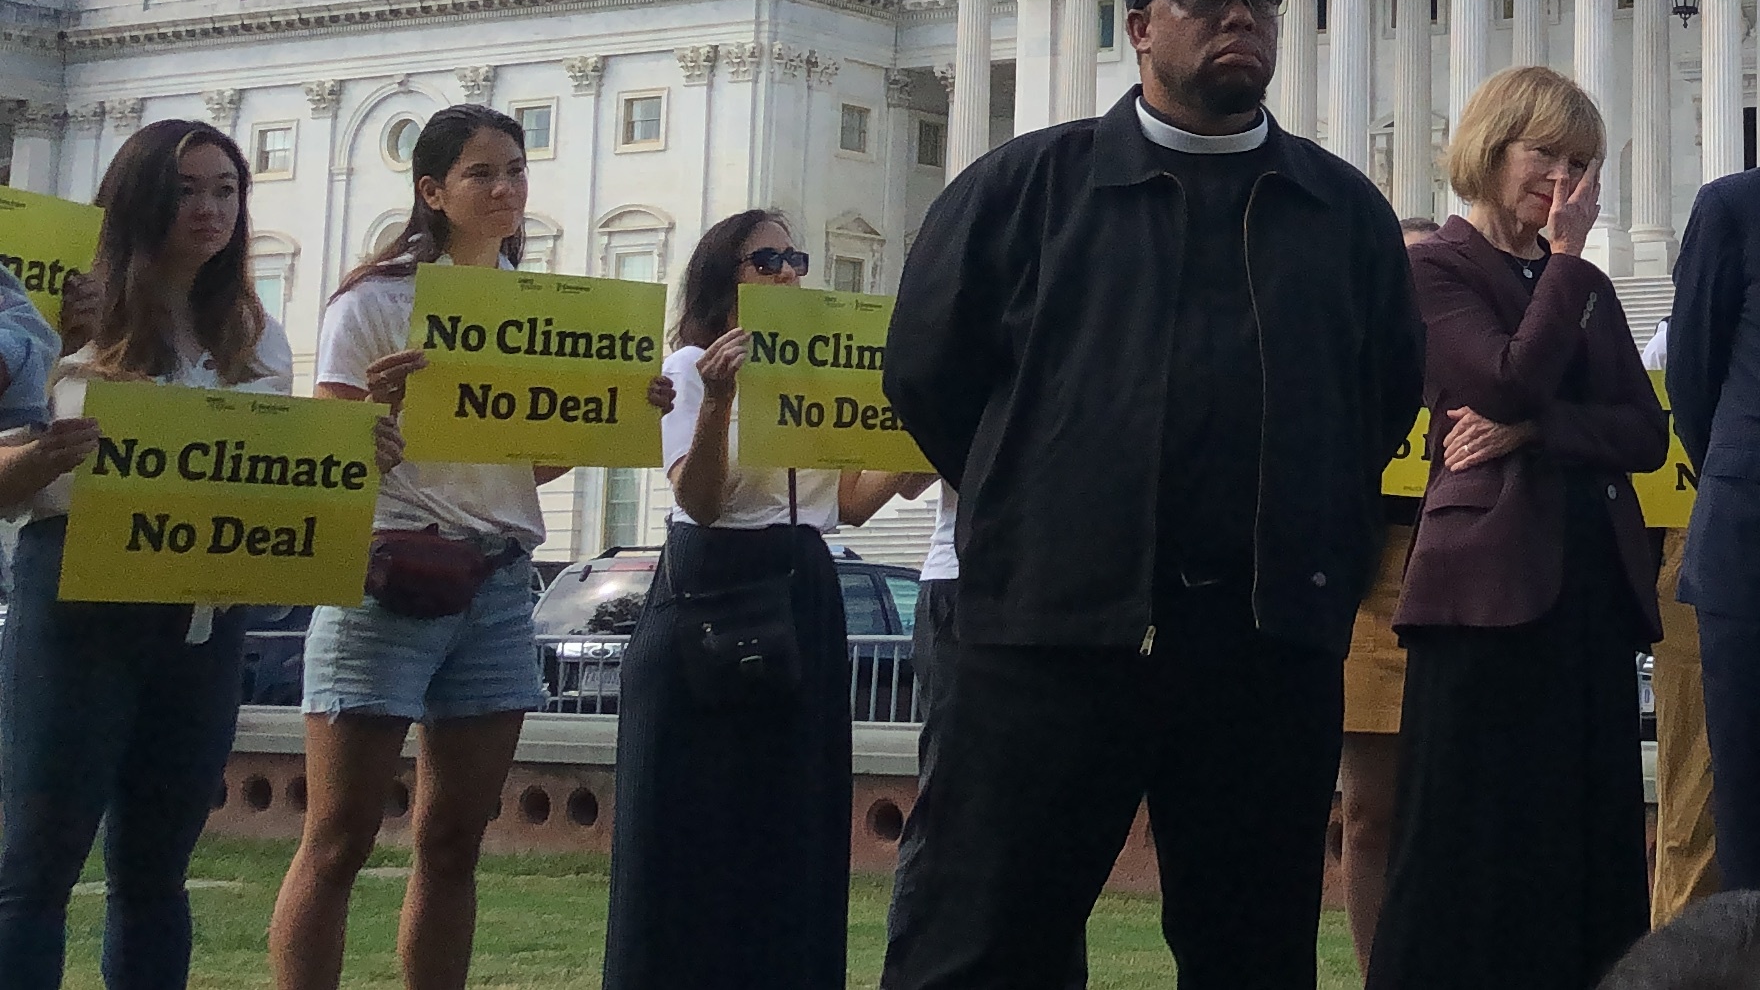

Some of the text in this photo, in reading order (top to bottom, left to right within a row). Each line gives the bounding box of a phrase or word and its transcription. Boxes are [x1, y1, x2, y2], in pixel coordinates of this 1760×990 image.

[423, 314, 655, 363] No Climate
[751, 331, 886, 370] No Clim
[455, 383, 618, 424] No Deal
[778, 394, 908, 431] No Dea
[93, 437, 369, 490] No Climate
[126, 513, 316, 558] No Deal
